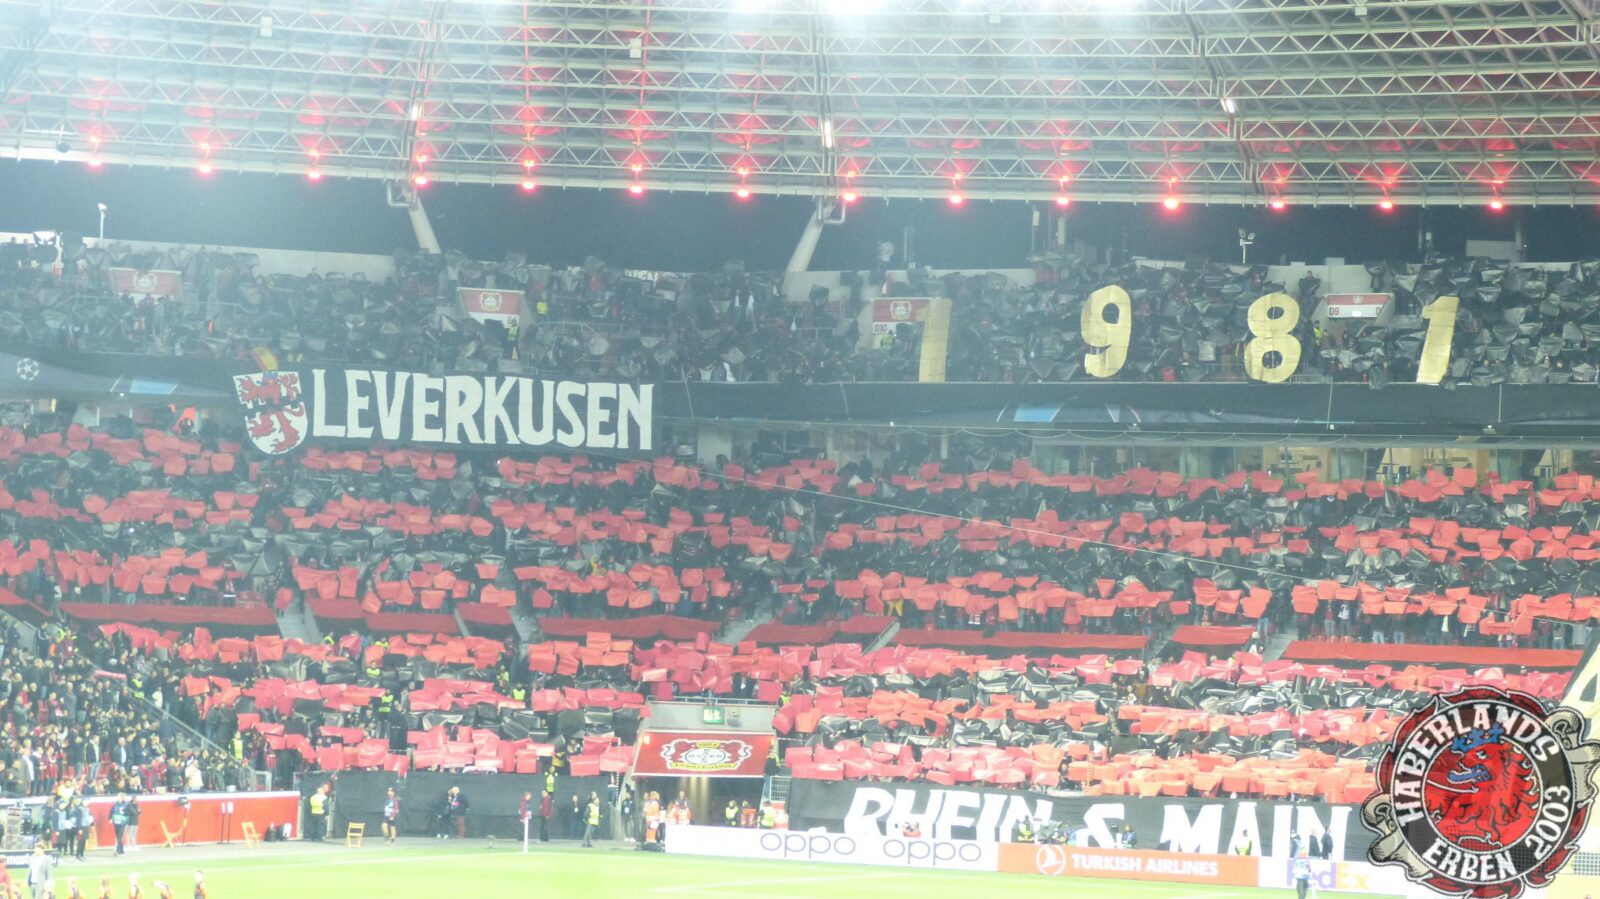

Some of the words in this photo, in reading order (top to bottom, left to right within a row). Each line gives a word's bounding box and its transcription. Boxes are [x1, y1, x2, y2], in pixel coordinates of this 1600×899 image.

[312, 368, 655, 450] LEVERKUSEN
[761, 832, 856, 859] oppo
[882, 838, 982, 866] oppo
[844, 787, 1053, 842] RHEIN
[1160, 801, 1352, 860] MAIN
[1072, 854, 1142, 873] TURKISH
[1145, 858, 1218, 878] AIRLINES
